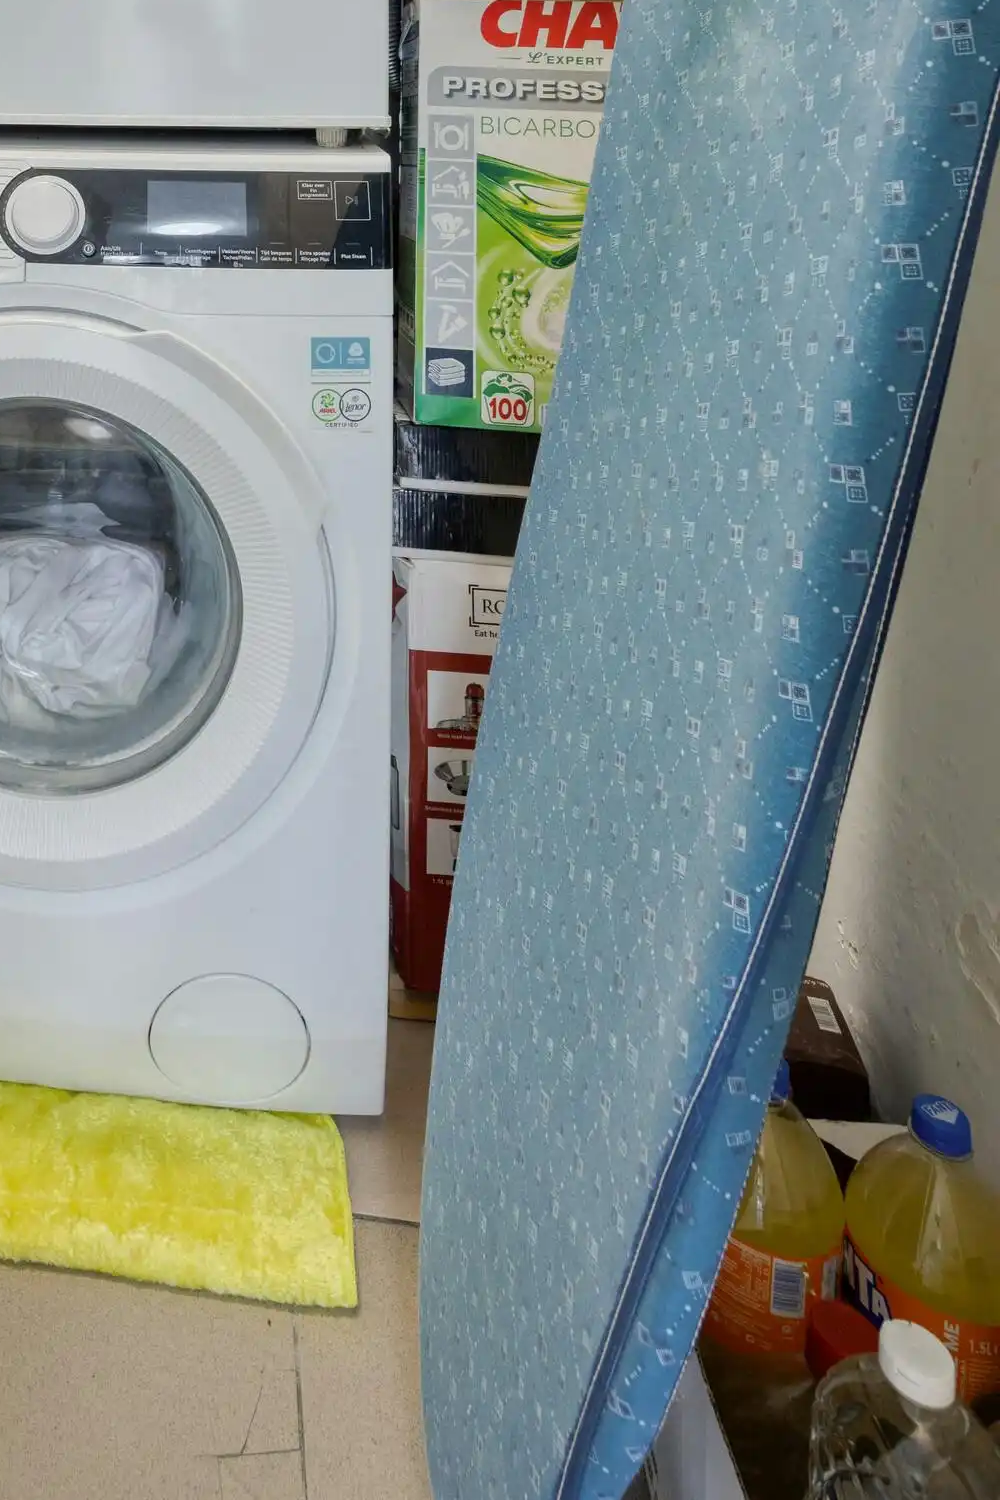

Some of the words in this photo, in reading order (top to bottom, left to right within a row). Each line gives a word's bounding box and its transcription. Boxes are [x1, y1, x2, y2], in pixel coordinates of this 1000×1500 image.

[526, 52, 605, 66] L'EXPERT
[480, 115, 602, 140] BICARBO
[489, 397, 528, 421] 100
[474, 629, 488, 638] Eat
